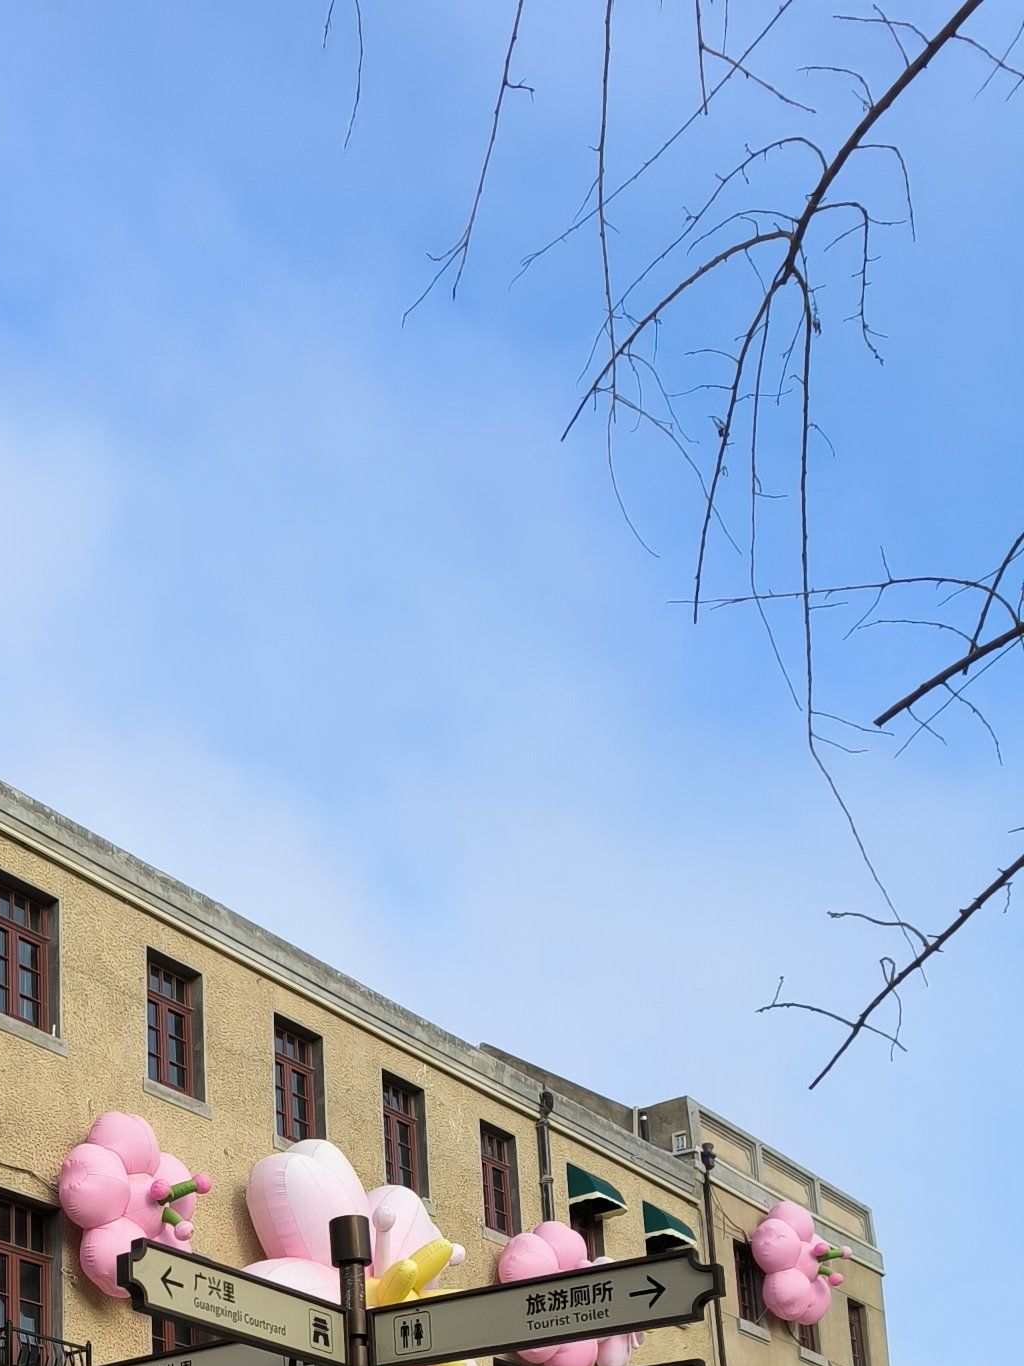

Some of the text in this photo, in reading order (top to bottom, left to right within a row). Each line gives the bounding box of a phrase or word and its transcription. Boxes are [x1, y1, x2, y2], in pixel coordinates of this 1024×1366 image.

[193, 1272, 236, 1304] 广兴里
[526, 1281, 614, 1316] 旅游厕所
[193, 1297, 287, 1336] Guangxingli Courtryard
[527, 1308, 610, 1331] Tourist Toilet
